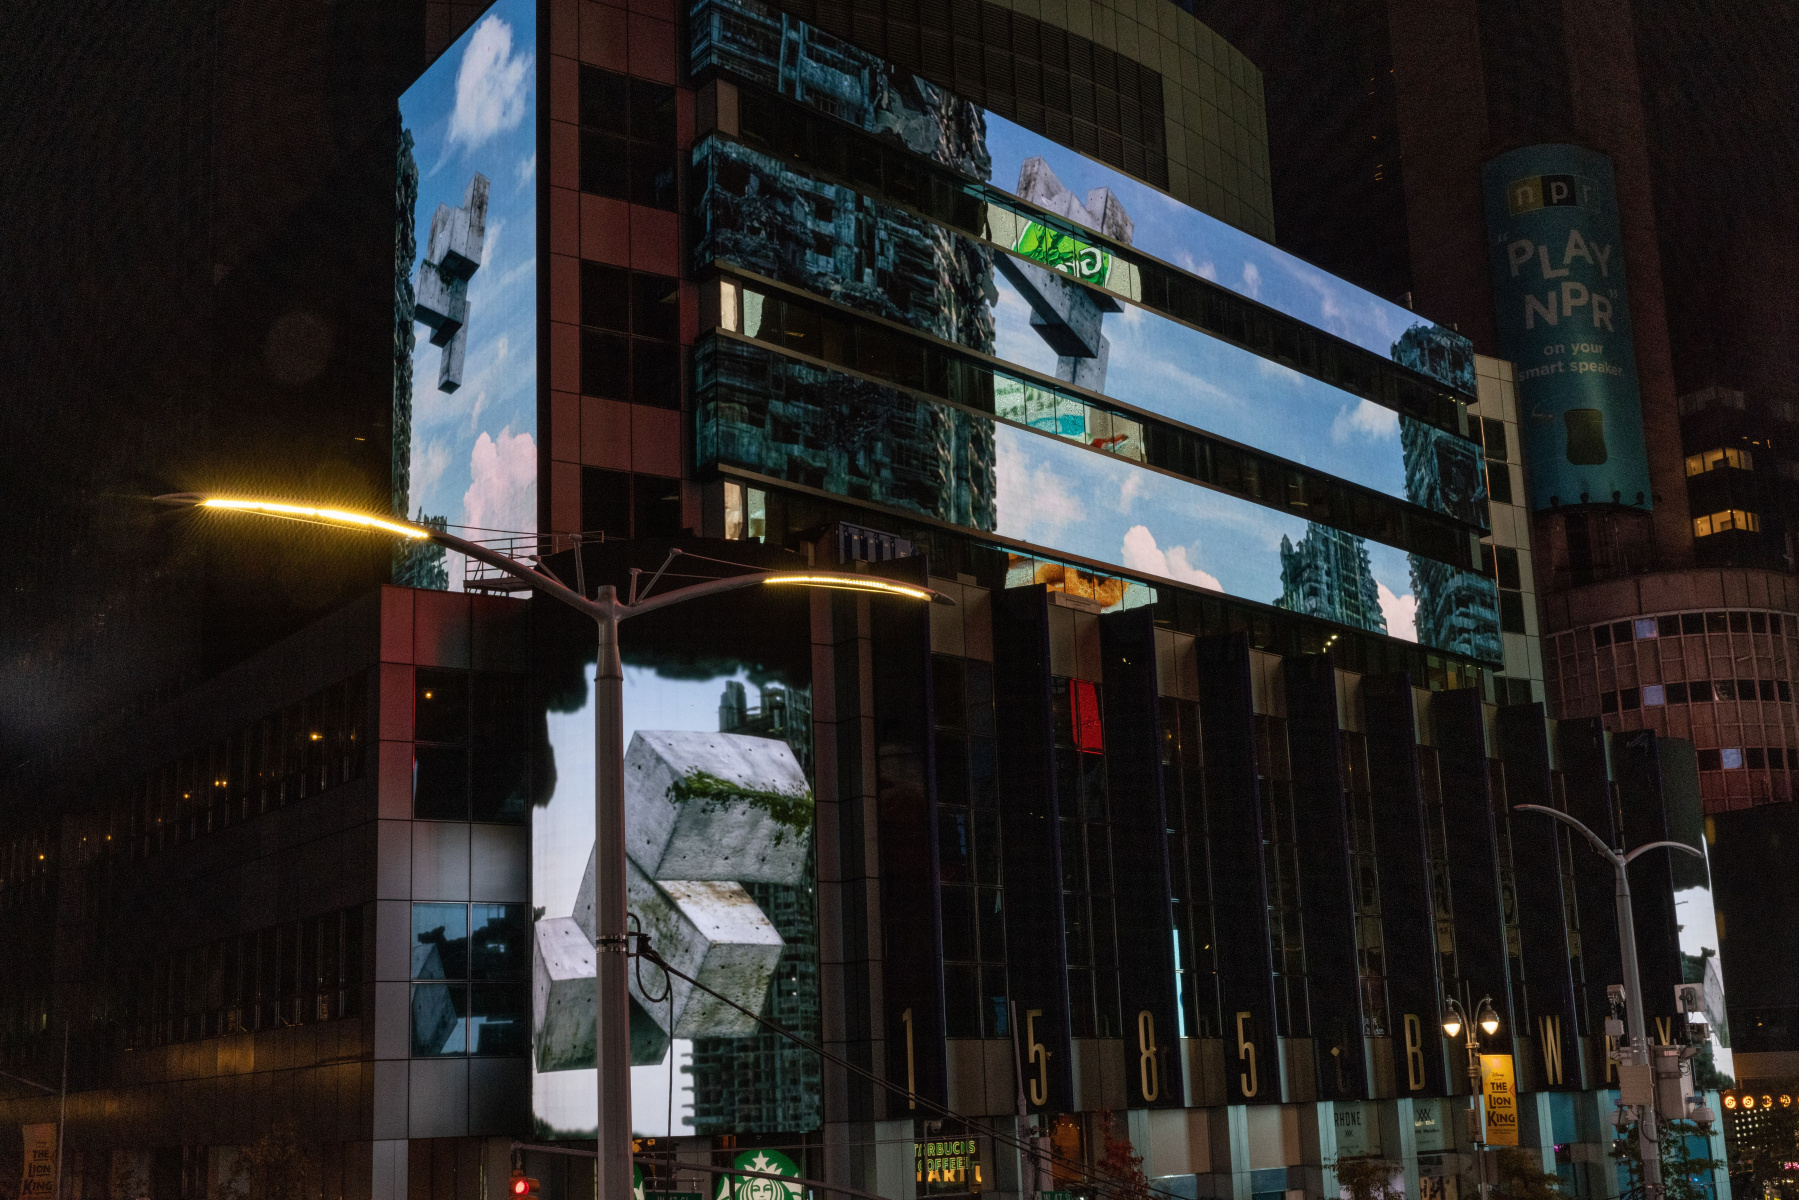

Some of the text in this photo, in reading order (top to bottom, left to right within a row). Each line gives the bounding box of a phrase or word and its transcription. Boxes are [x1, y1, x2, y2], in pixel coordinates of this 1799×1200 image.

[1516, 181, 1592, 205] npr
[1544, 342, 1603, 356] on your
[1519, 363, 1564, 382] smart
[1490, 1082, 1507, 1090] THE
[1488, 1094, 1511, 1109] LION
[1335, 1111, 1361, 1127] RHONE
[1487, 1110, 1515, 1127] KING
[33, 1150, 48, 1158] THE
[914, 1140, 976, 1157] TARBUCKS
